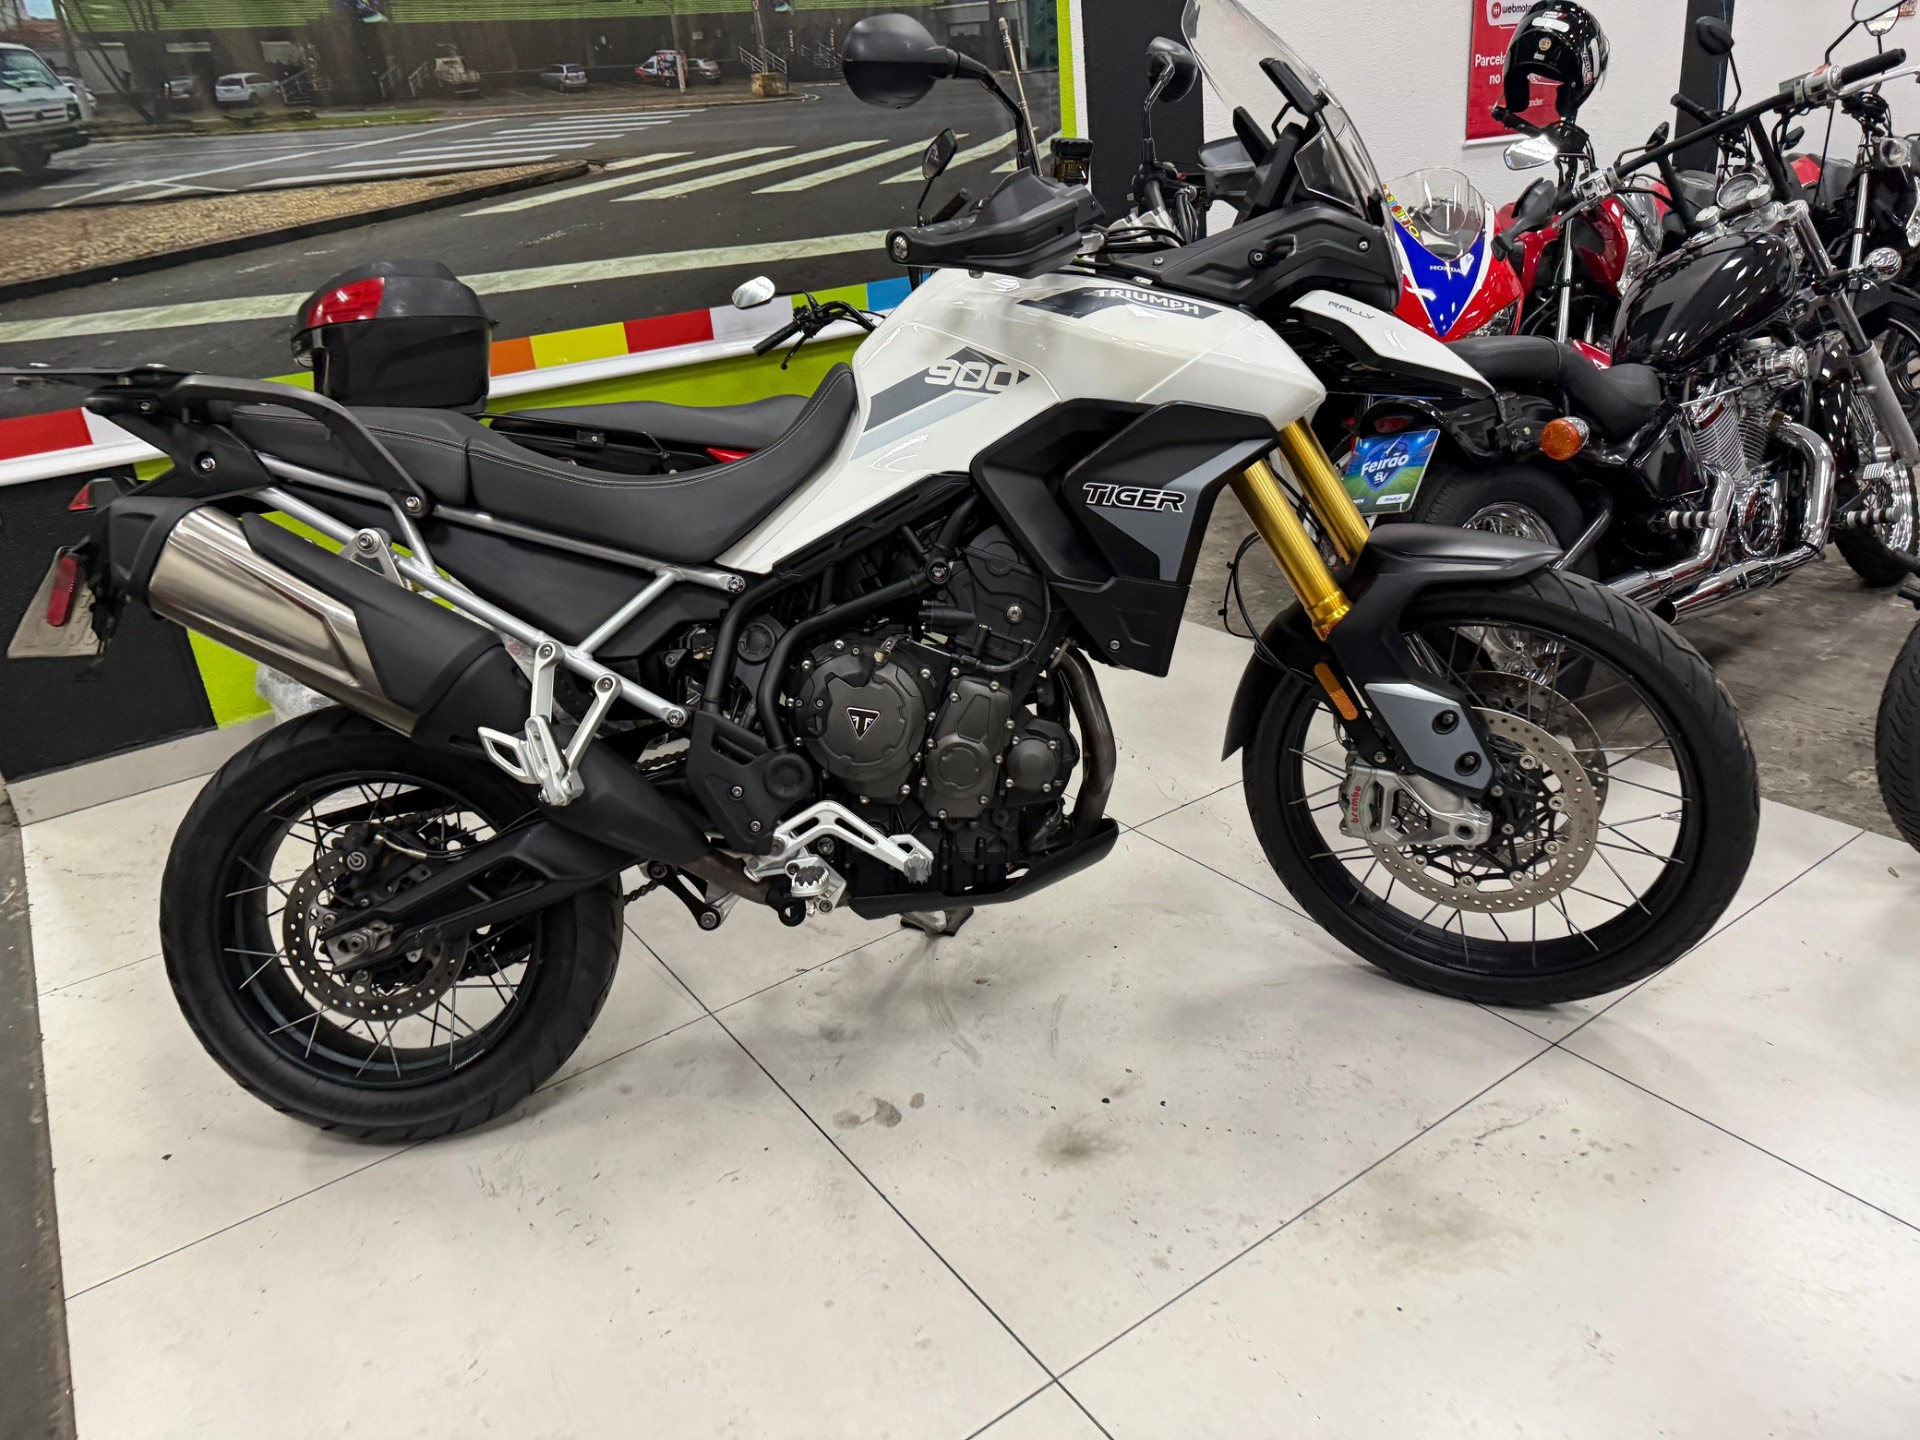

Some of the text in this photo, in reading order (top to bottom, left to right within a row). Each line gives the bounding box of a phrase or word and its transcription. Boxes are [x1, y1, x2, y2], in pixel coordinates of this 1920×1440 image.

[1489, 74, 1501, 85] no
[1429, 265, 1462, 274] HONDA
[1094, 288, 1200, 315] TRIUMPH
[1327, 300, 1376, 320] RALLY
[924, 358, 1020, 392] 900
[1360, 452, 1410, 477] Feirão
[1083, 482, 1187, 513] TIGER
[1350, 785, 1361, 825] brembo
